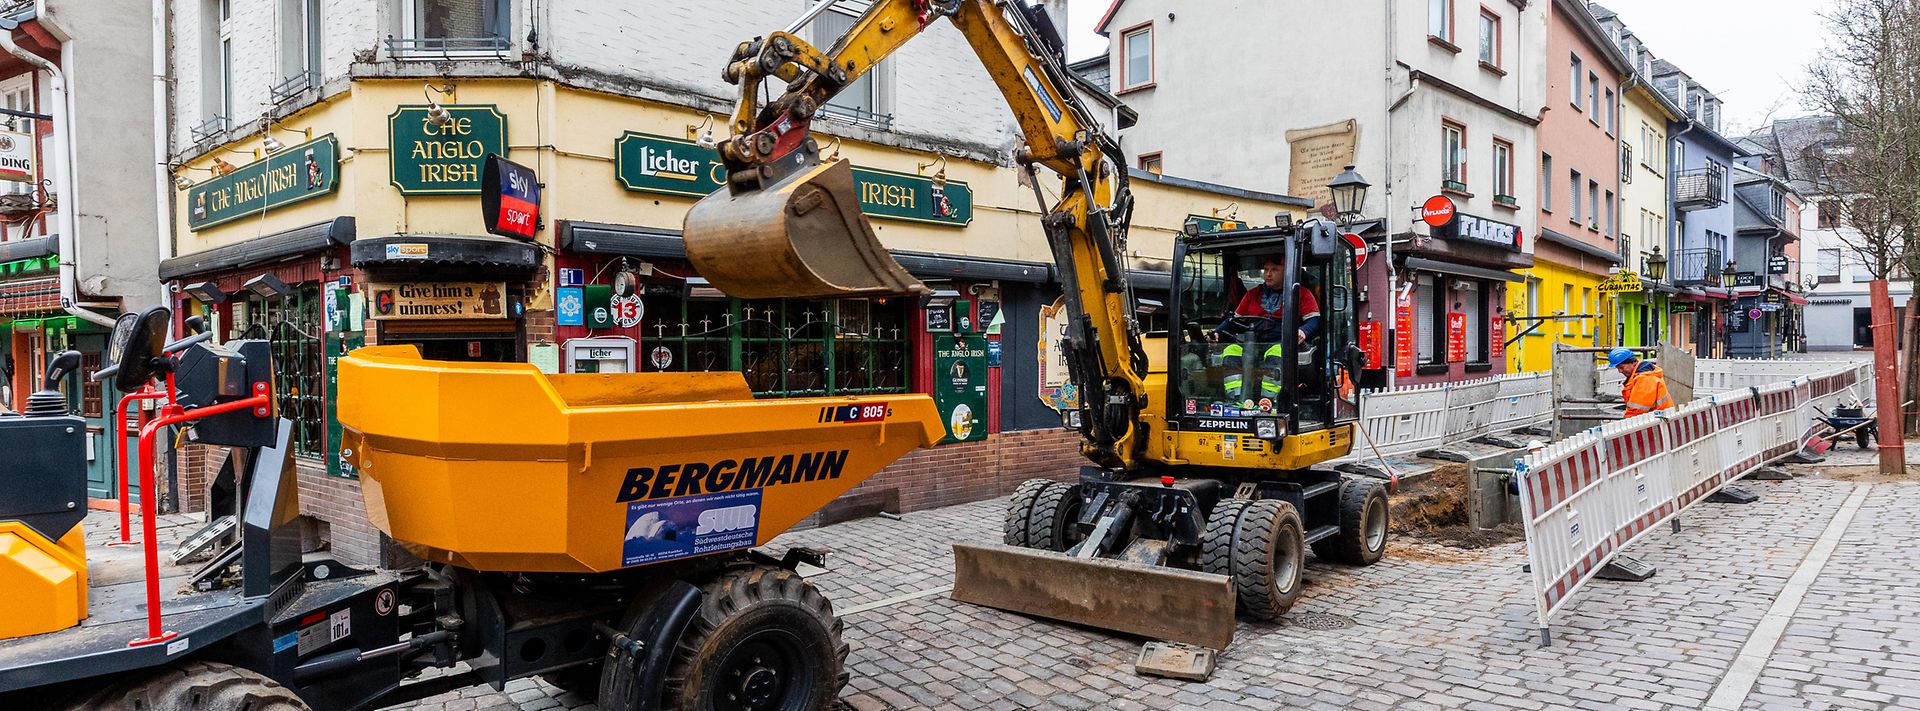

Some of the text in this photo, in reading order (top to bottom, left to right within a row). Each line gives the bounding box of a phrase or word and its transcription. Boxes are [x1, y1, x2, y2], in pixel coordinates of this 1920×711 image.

[422, 118, 472, 135] THE
[412, 141, 484, 159] ANGLO
[1, 157, 30, 170] DING
[640, 146, 699, 176] Licher
[419, 164, 478, 182] IRISH
[212, 163, 297, 212] THE ANGLO IRISH
[508, 170, 528, 198] sky
[861, 181, 915, 208] IRISH
[506, 208, 530, 226] sport
[387, 246, 427, 255] sky sport
[569, 270, 574, 283] 1
[399, 284, 474, 298] Give him a
[1598, 283, 1640, 291] CUBANITAS
[613, 302, 637, 319] 13
[590, 349, 612, 359] Licher
[938, 350, 950, 358] THE
[850, 406, 858, 419] C
[862, 405, 884, 418] 805
[1199, 420, 1248, 429] ZEPPELIN
[616, 450, 849, 503] BERGMANN
[694, 531, 753, 546] Südwestdeutsche
[693, 540, 752, 554] Rohrleitungsbau
[332, 622, 345, 640] 101
